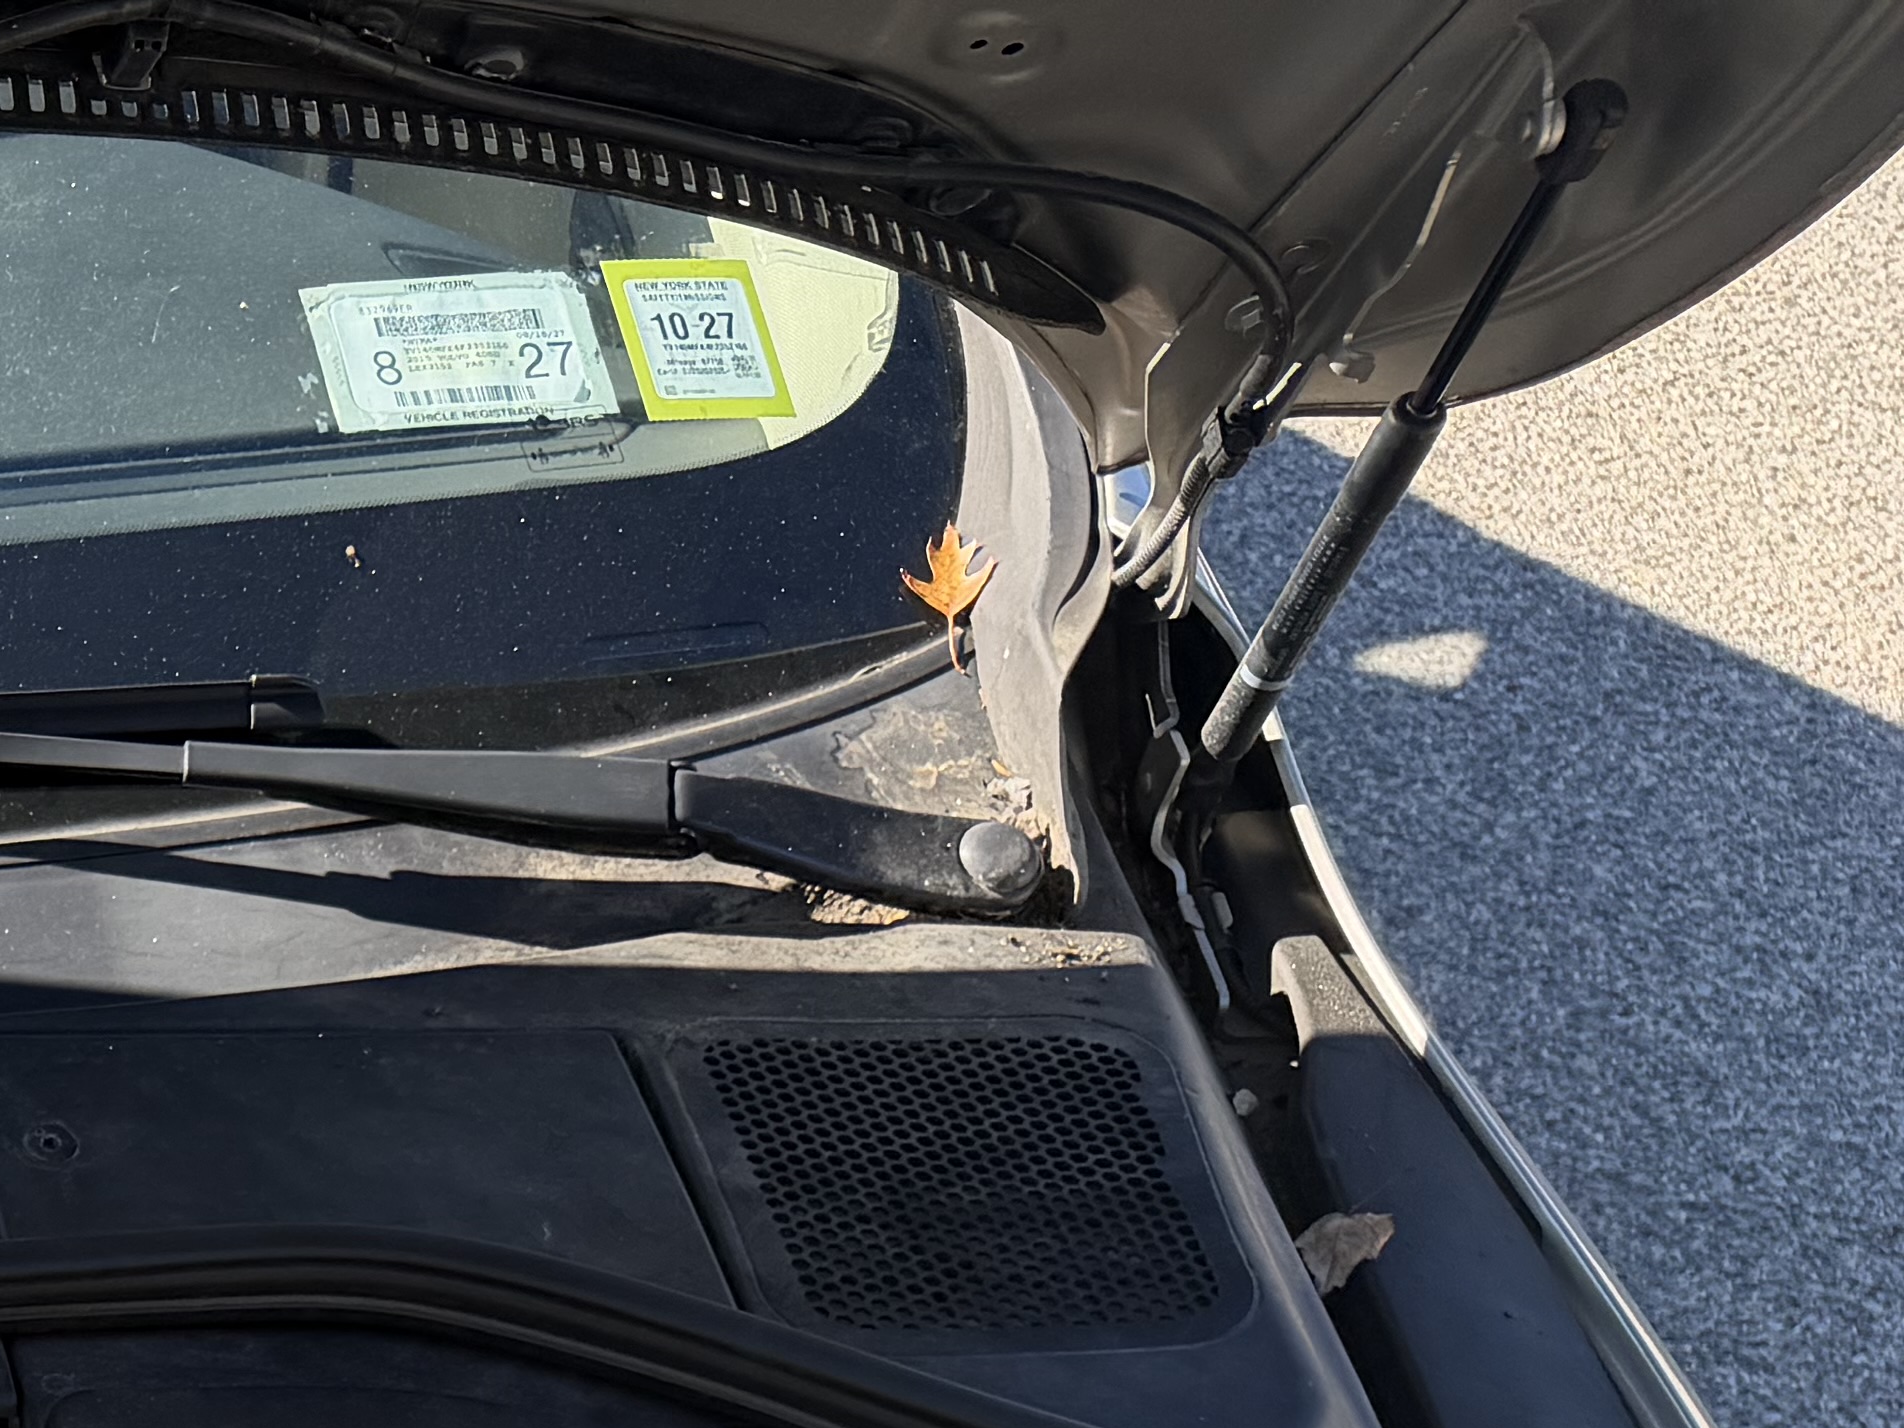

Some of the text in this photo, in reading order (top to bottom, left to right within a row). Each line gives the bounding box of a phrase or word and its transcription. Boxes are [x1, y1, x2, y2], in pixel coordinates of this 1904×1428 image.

[660, 280, 692, 290] YORK
[692, 280, 728, 290] STATE
[648, 311, 740, 339] 10-27
[370, 350, 405, 385] 8
[514, 339, 584, 378] 27
[403, 410, 460, 424] VEHICLE
